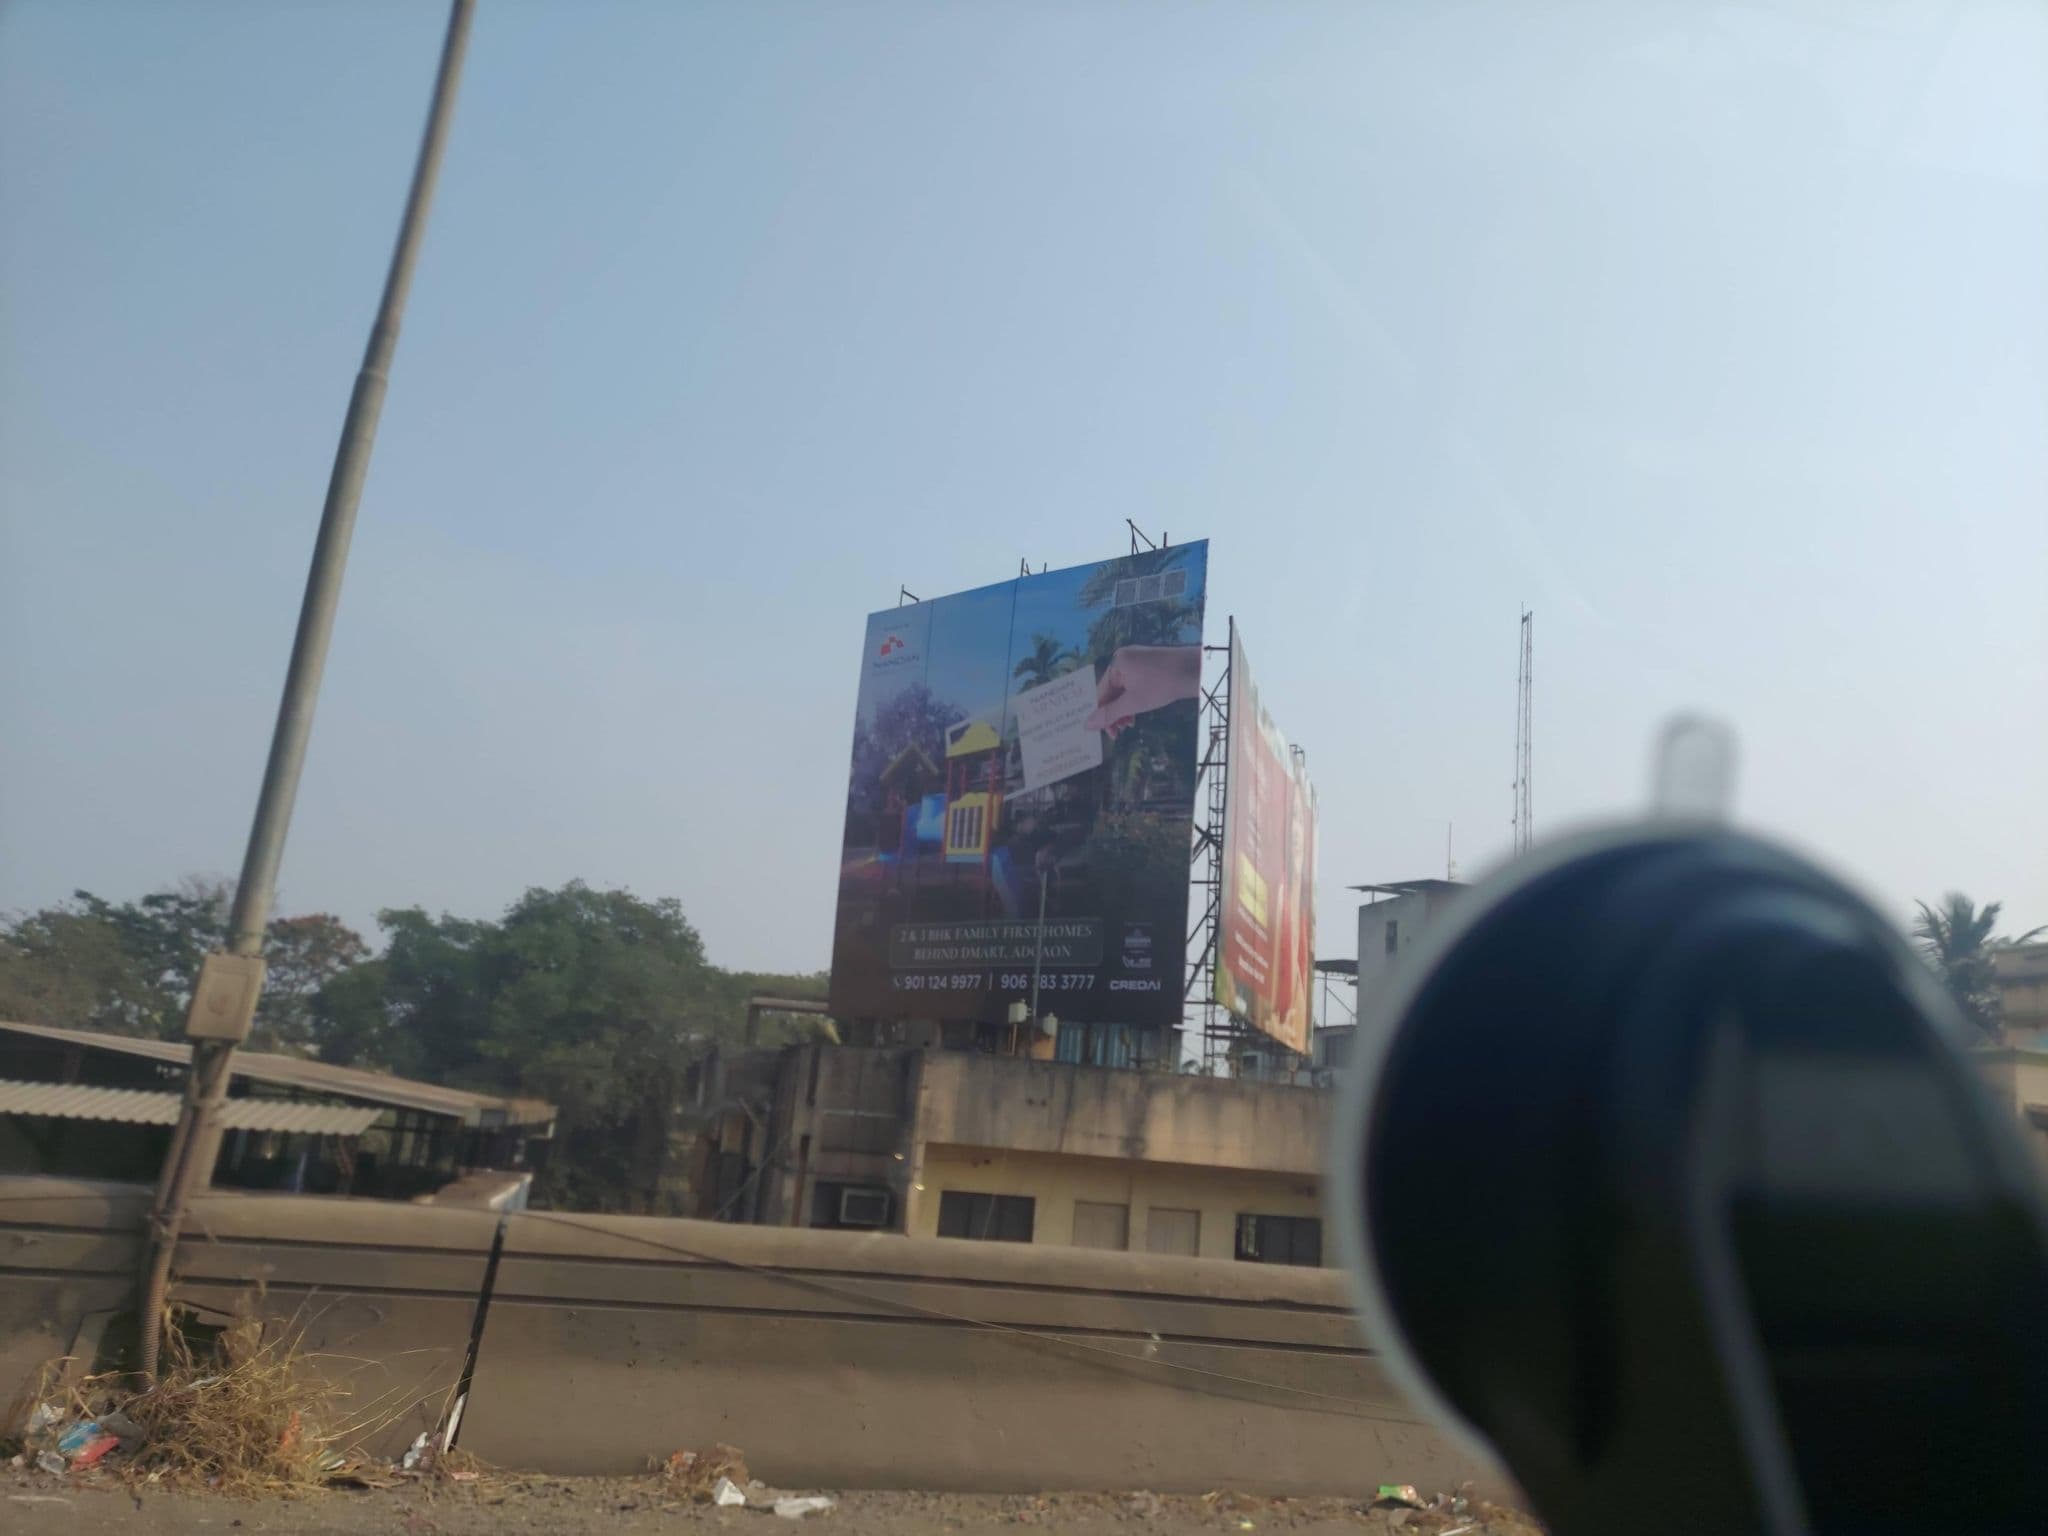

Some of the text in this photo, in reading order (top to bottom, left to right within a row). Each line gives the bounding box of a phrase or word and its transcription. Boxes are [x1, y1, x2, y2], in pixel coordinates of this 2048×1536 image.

[955, 926, 999, 939] FAMILY
[1002, 925, 1039, 938] FIRST
[1043, 923, 1092, 937] HOMES
[914, 947, 958, 960] BEHIND
[904, 975, 925, 990] 901
[928, 975, 947, 990] 124
[951, 974, 982, 990] 9977
[1001, 974, 1028, 990] 906
[1061, 973, 1095, 990] 3777
